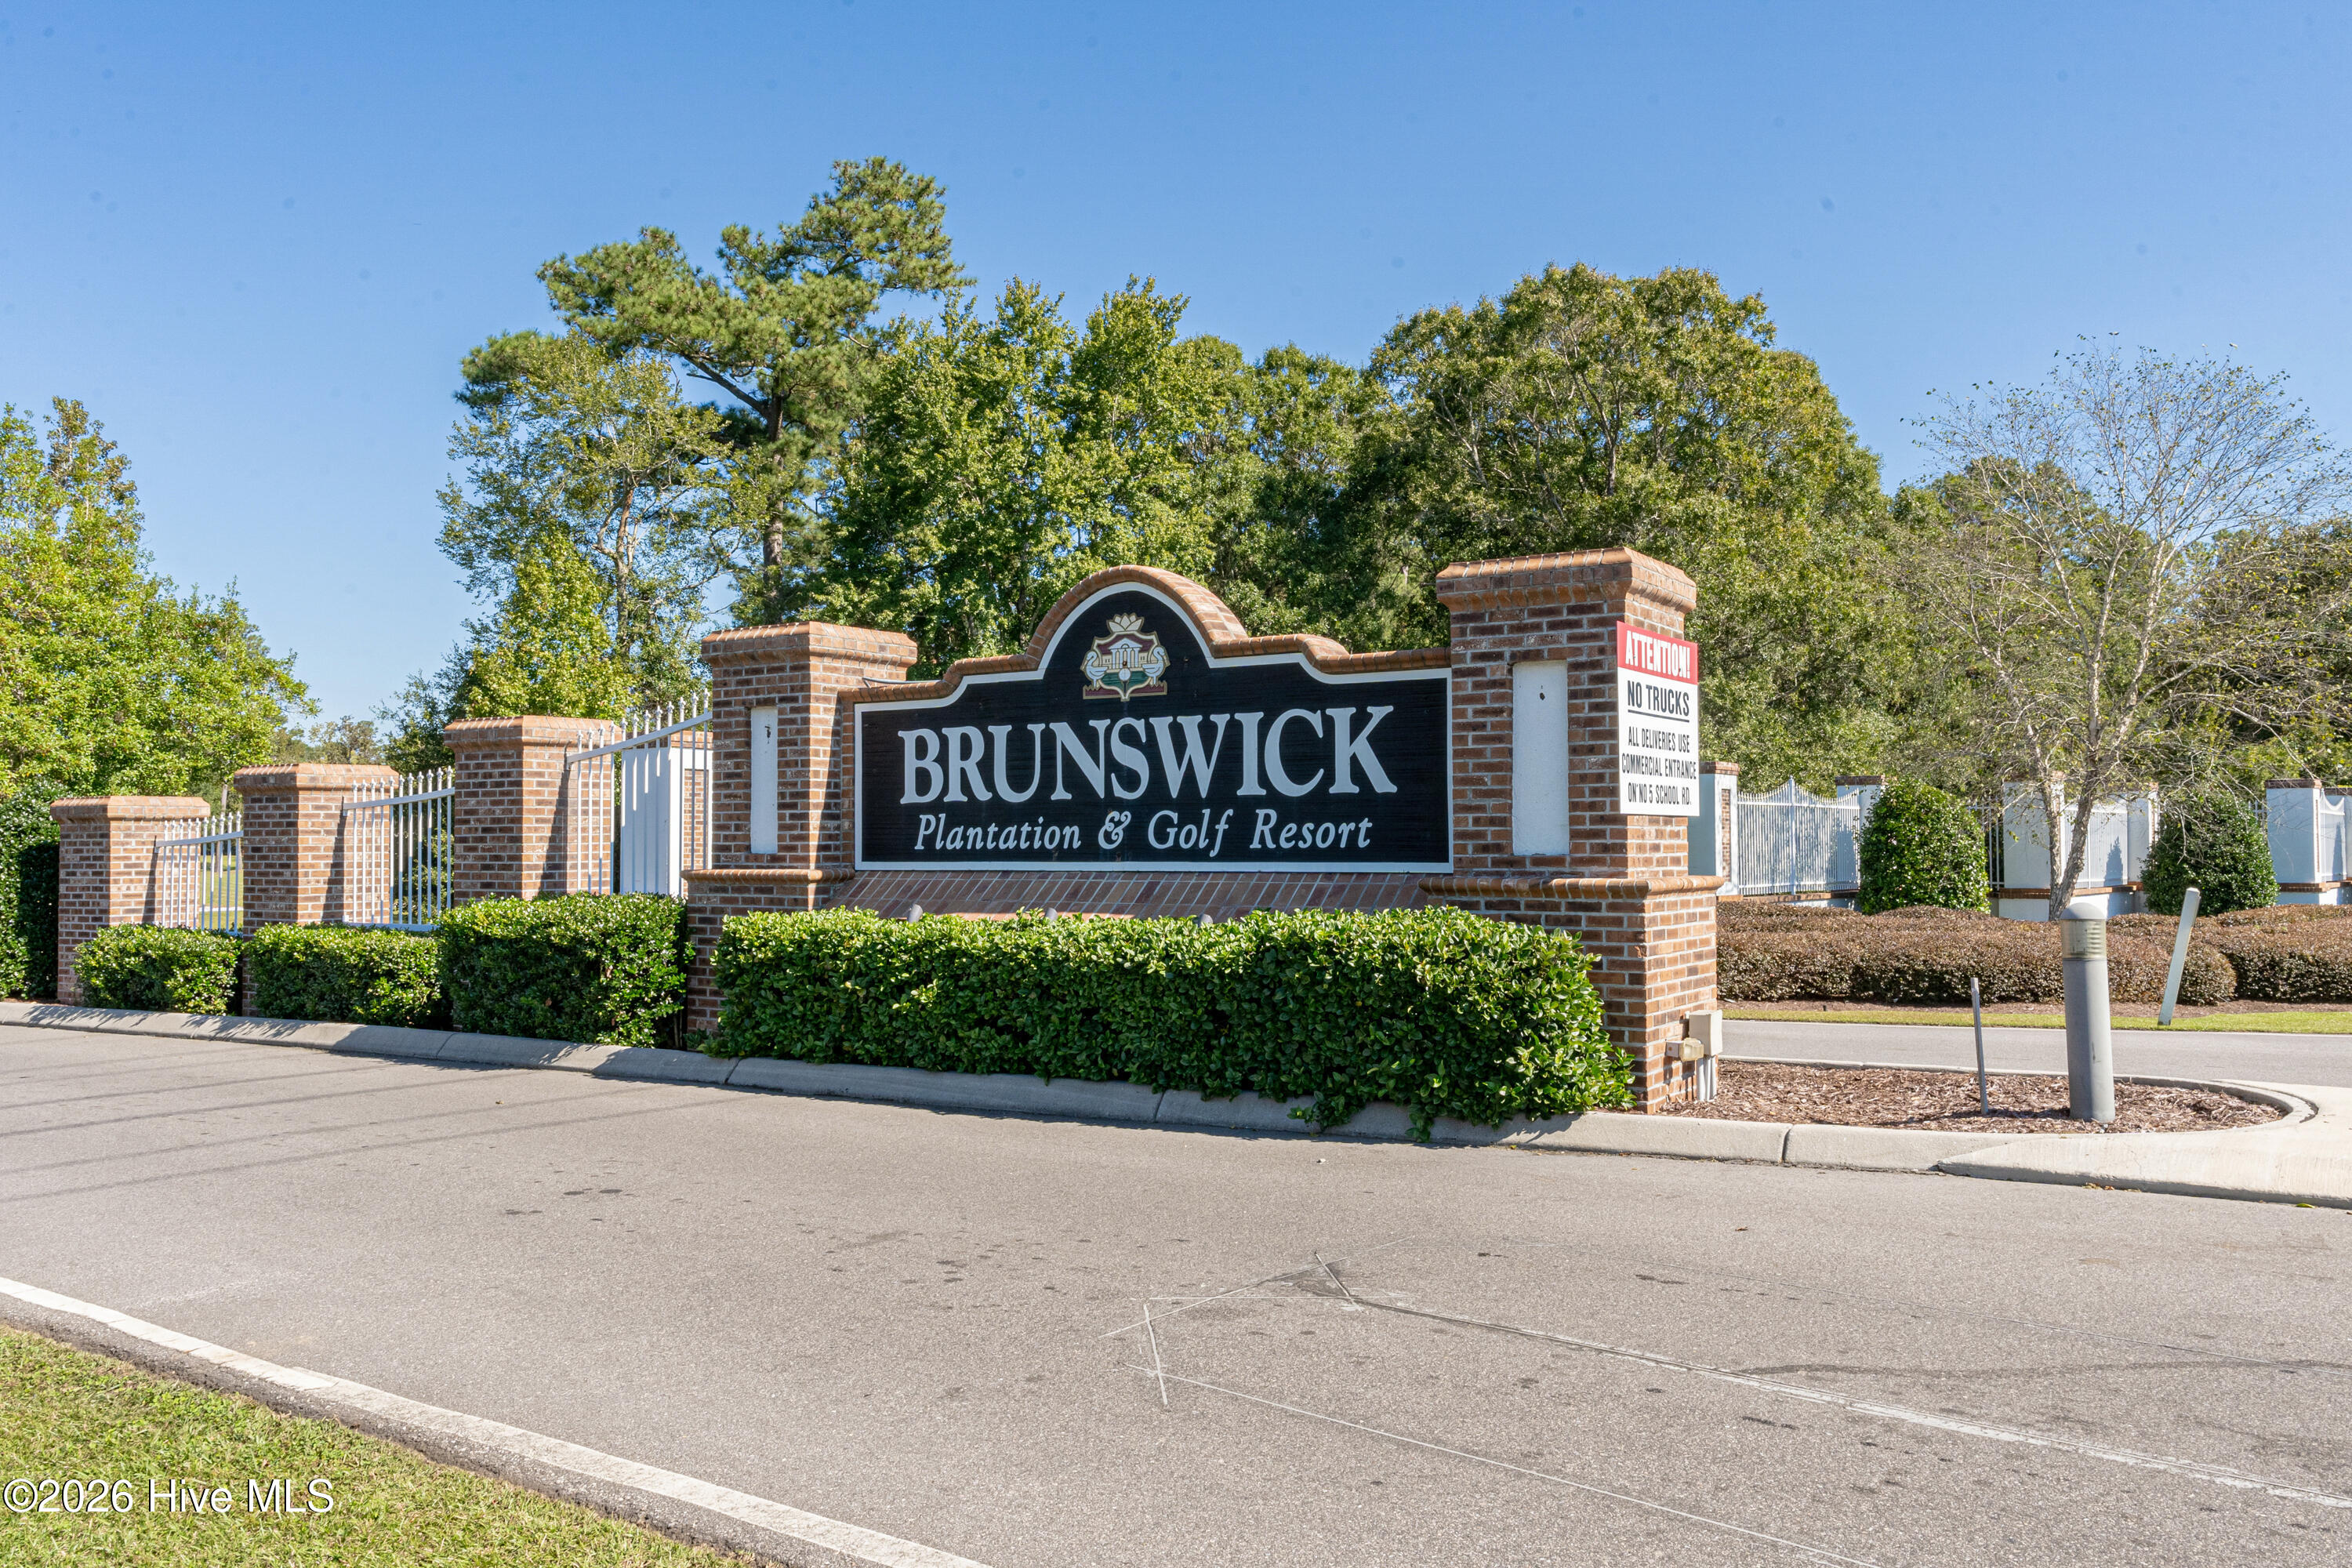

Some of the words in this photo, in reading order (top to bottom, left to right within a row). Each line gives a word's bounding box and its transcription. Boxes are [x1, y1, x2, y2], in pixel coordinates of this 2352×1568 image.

[1625, 630, 1690, 679] ATTENTION!
[1627, 681, 1642, 709] NO
[1646, 684, 1690, 717] TRUCKS
[898, 706, 1398, 804] BRUNSWICK
[1628, 726, 1639, 747] ALL
[1642, 728, 1675, 753] DELIVERIES
[1678, 734, 1690, 753] USE
[1621, 753, 1662, 777] COMMERCIAL
[1664, 758, 1697, 780] ENTRANCE
[1628, 782, 1636, 803] ON
[1639, 783, 1647, 804] NO
[1649, 784, 1653, 804] 5
[1655, 785, 1679, 805] SCHOOL
[1682, 786, 1692, 805] RD.
[914, 813, 1081, 851] Plantation
[1098, 810, 1131, 850] &
[1147, 808, 1234, 858] Golf
[1249, 808, 1373, 850] Resort
